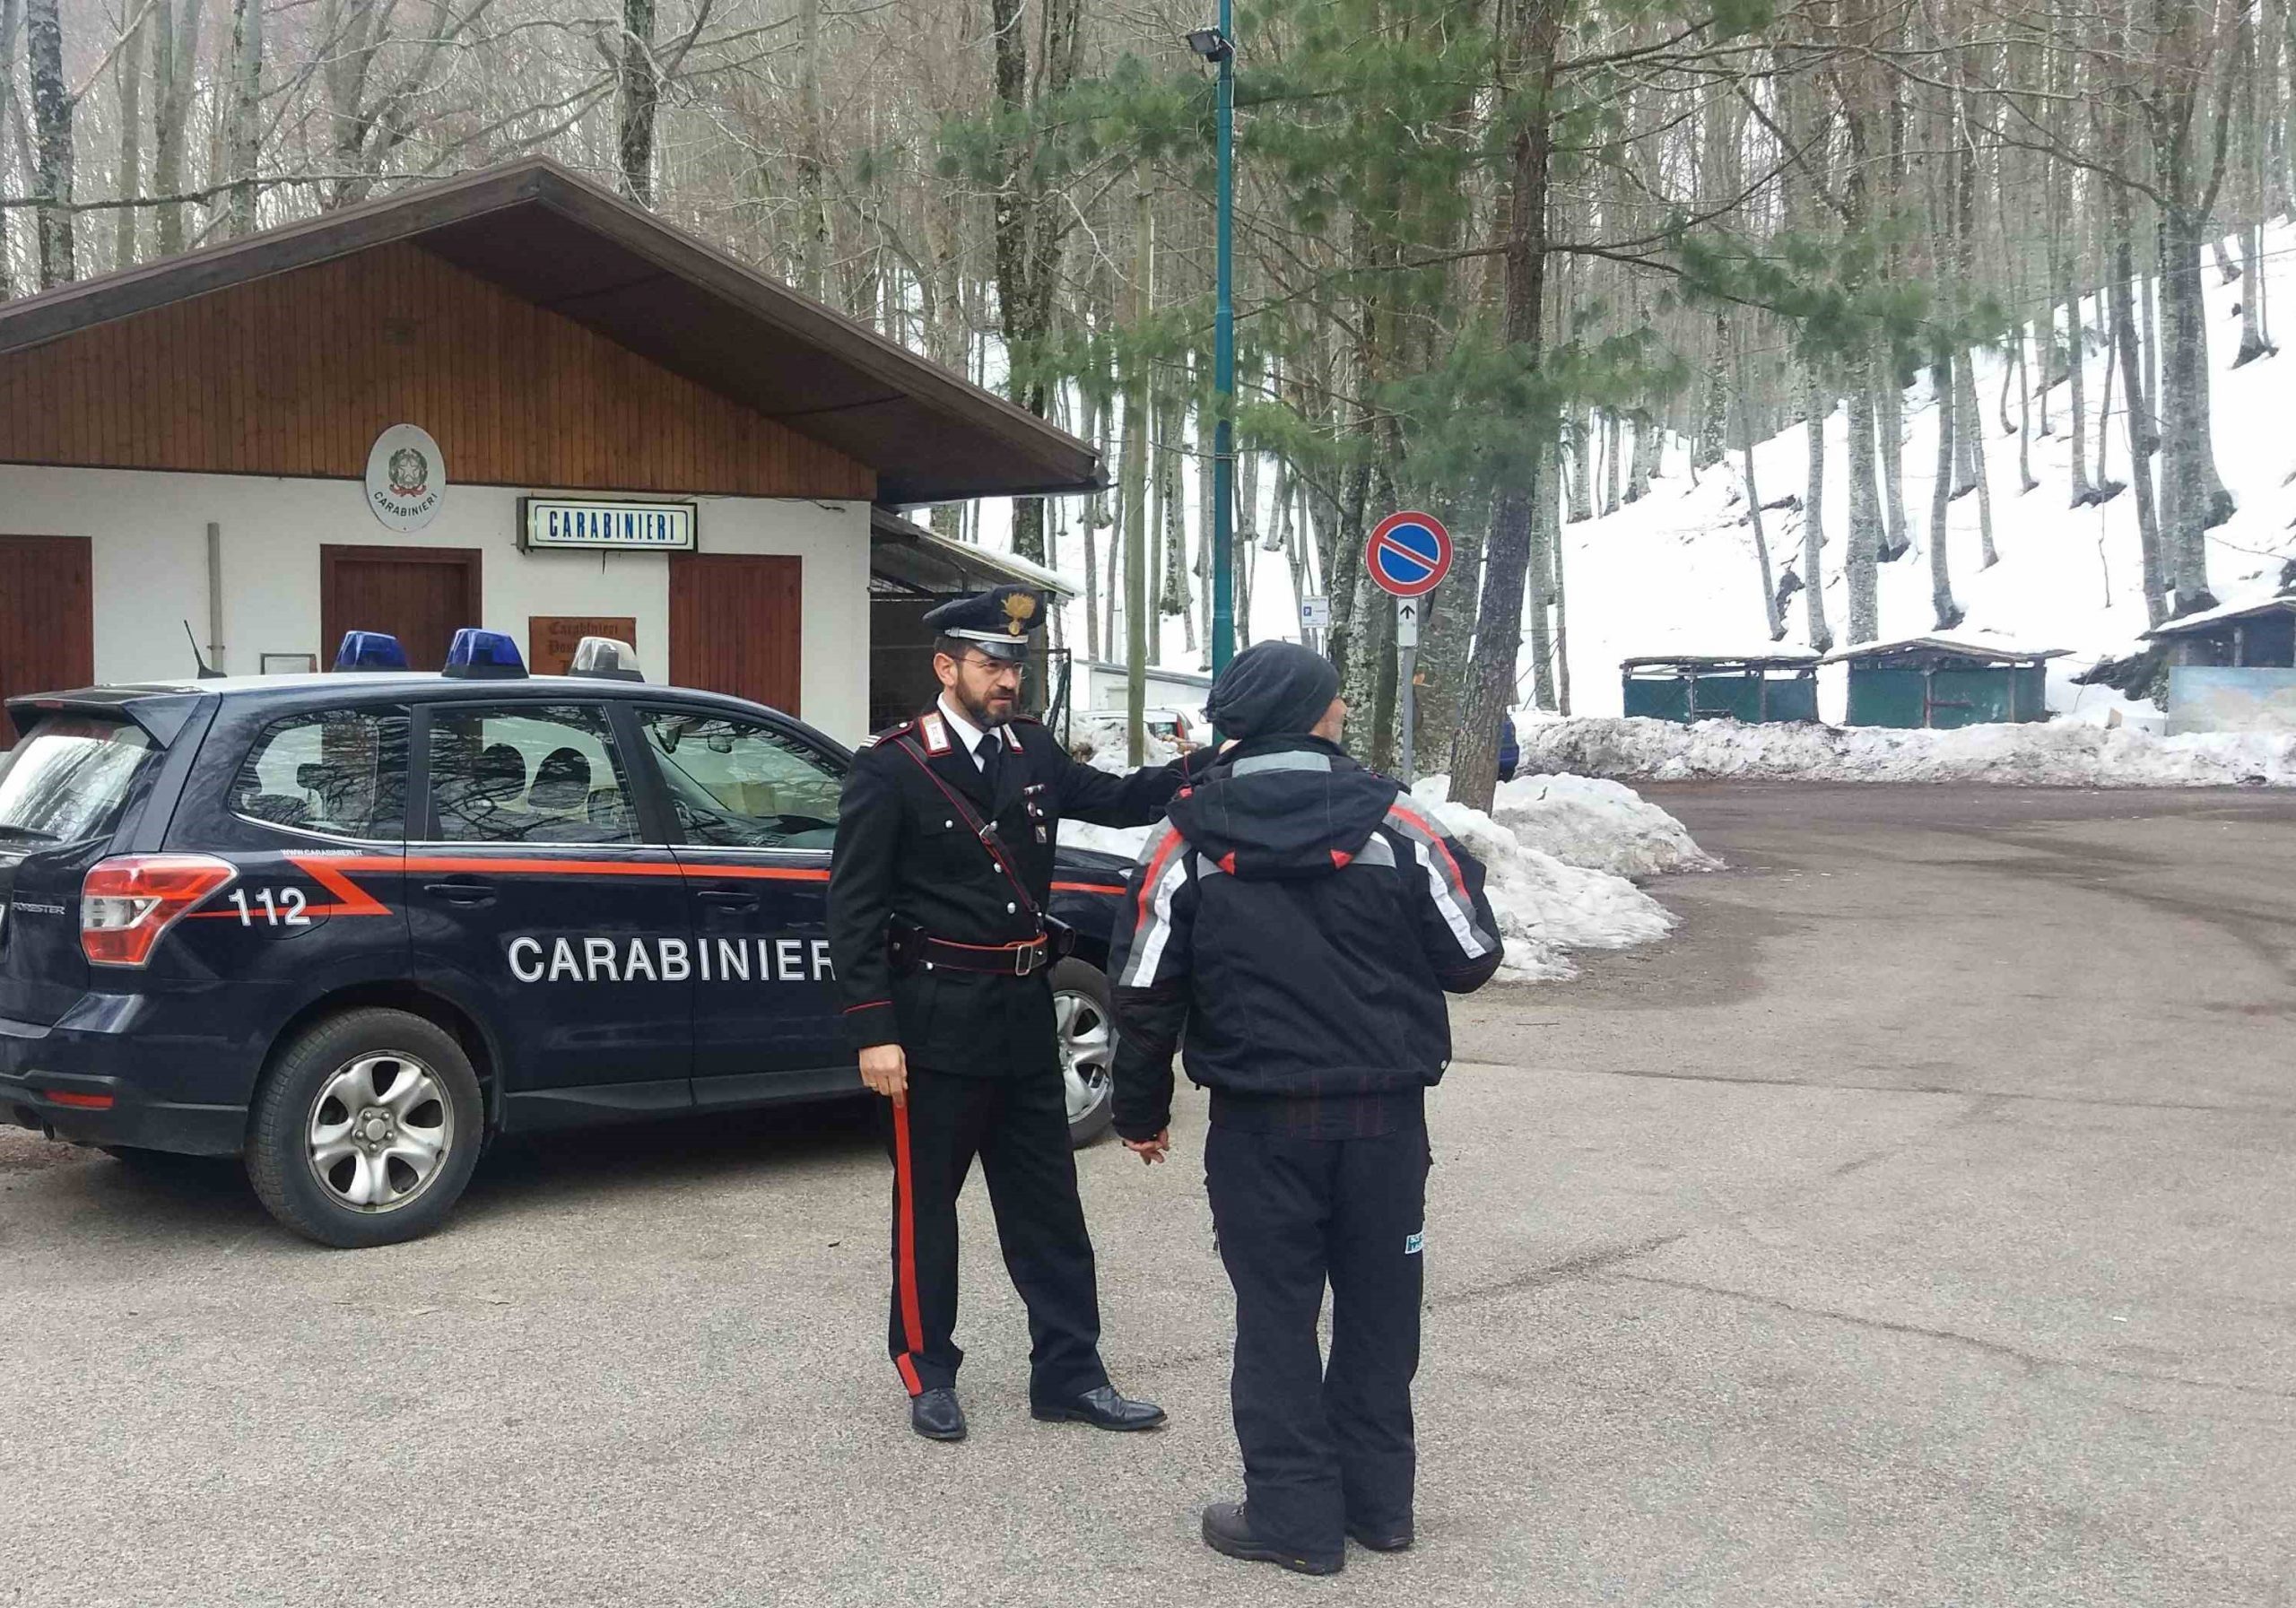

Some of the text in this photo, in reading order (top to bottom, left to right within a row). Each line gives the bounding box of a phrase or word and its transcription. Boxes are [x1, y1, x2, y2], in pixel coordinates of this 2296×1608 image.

[373, 491, 439, 517] CARABINIERI
[549, 510, 675, 541] CARABINIERI
[228, 887, 311, 926] 112
[509, 936, 837, 983] CARABINIER
